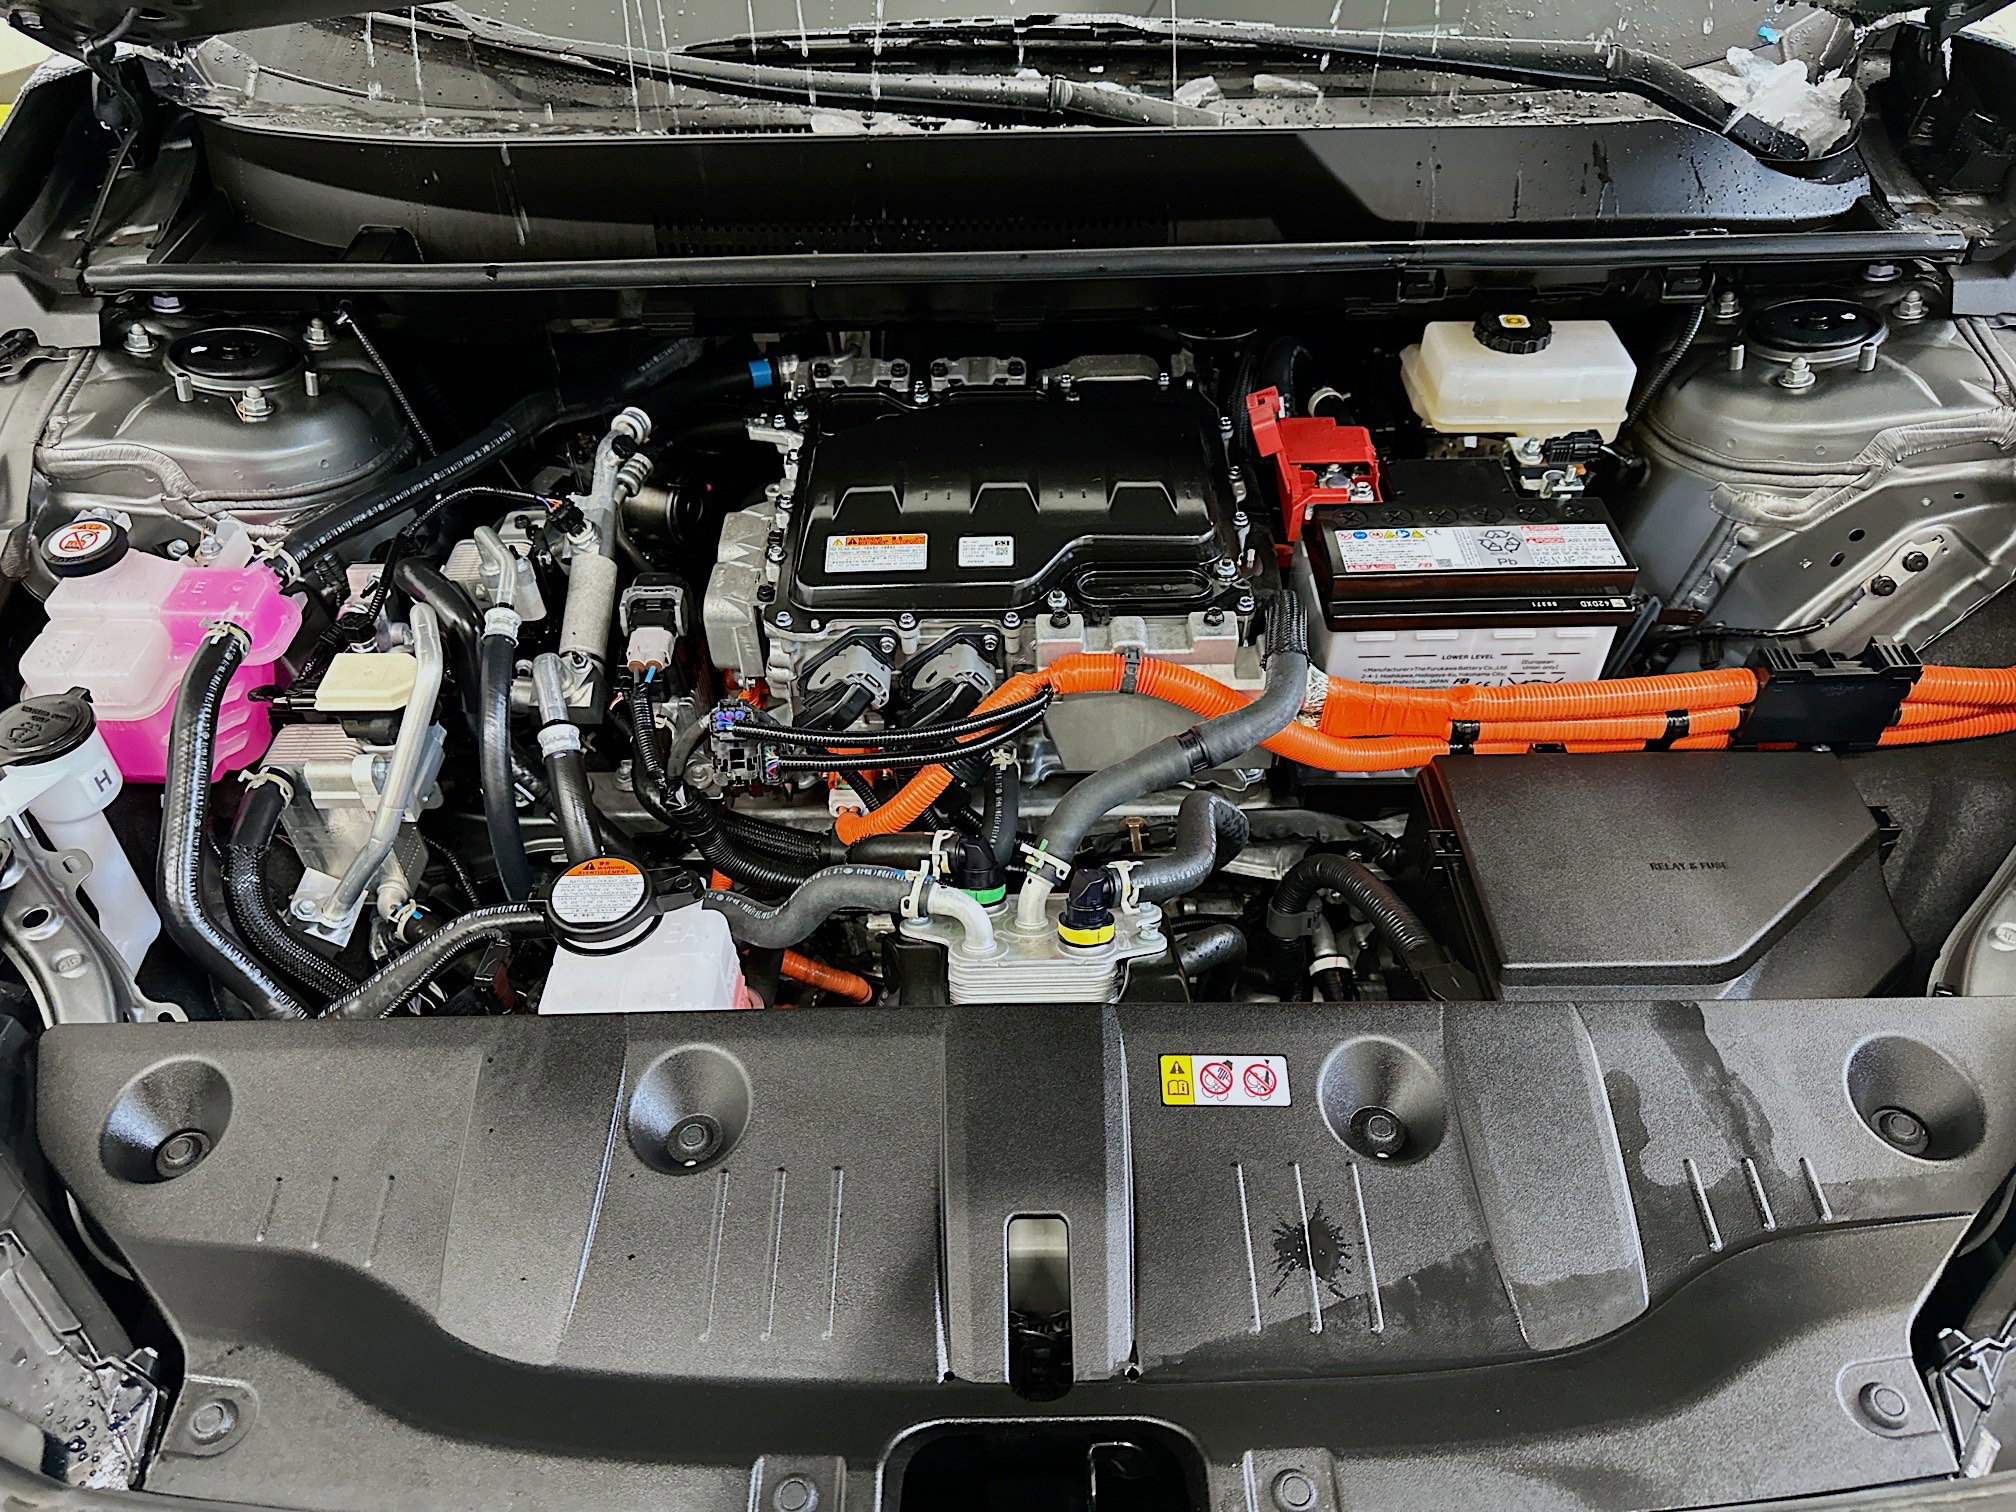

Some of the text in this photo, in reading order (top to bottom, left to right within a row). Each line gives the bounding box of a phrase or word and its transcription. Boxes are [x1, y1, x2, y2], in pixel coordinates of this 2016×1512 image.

[1498, 558, 1518, 566] Pb
[93, 768, 113, 793] H
[1649, 862, 1685, 870] RELAY
[1700, 861, 1728, 870] FUSE
